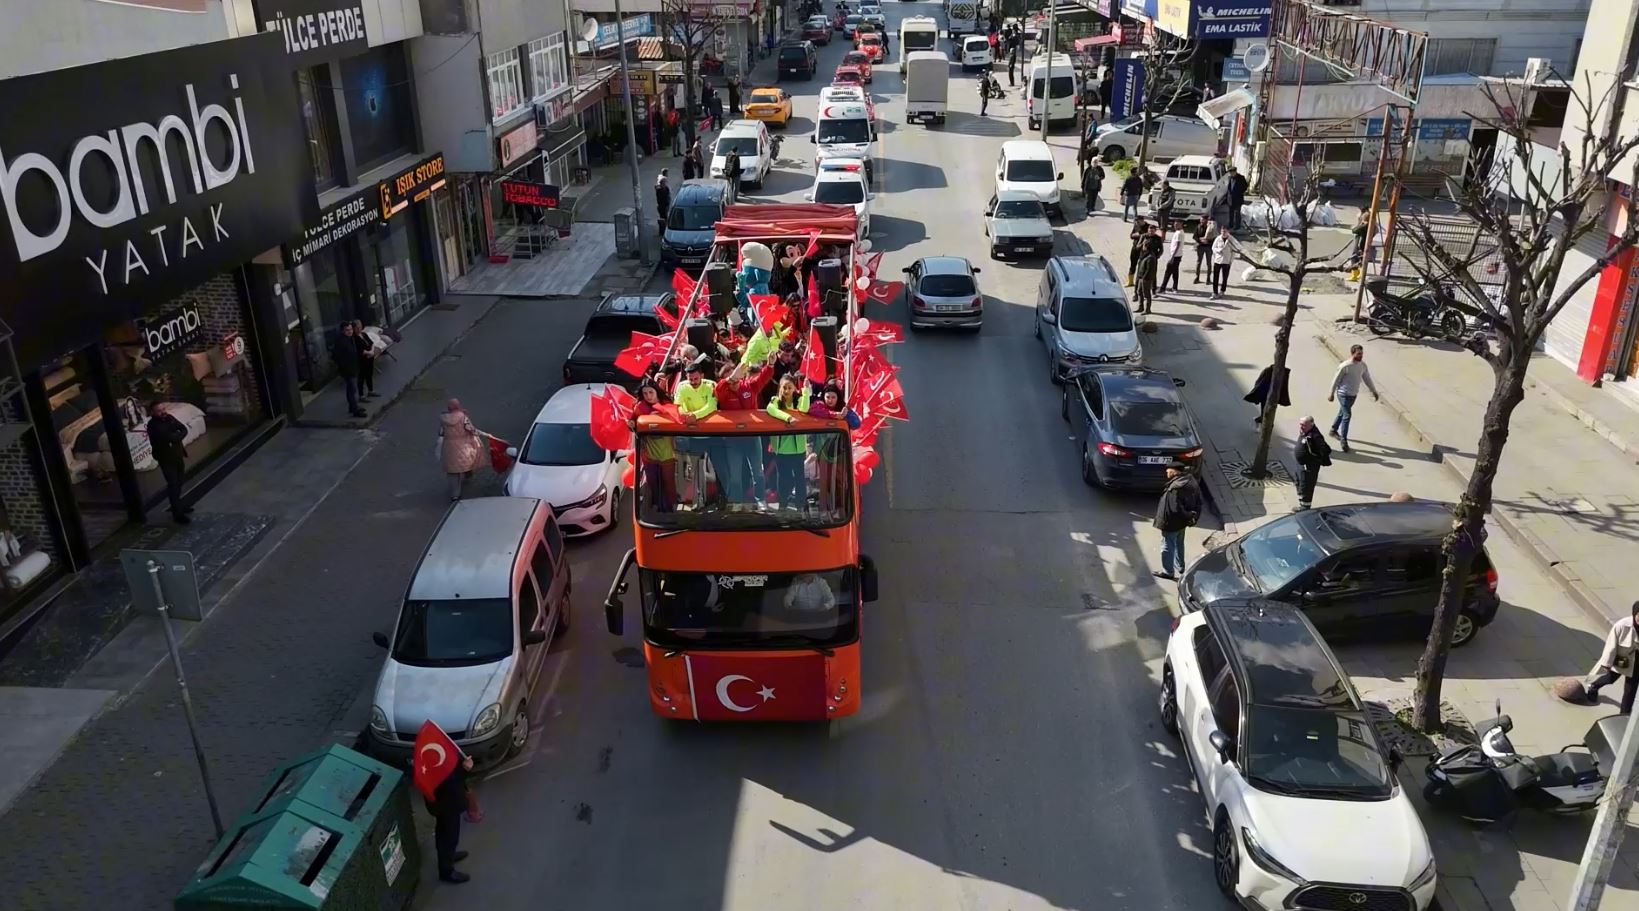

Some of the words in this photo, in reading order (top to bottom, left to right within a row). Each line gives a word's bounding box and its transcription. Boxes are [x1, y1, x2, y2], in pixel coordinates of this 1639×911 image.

[318, 7, 364, 46] PERDE
[1205, 23, 1226, 34] EMA
[1228, 21, 1262, 33] LASTİK
[1216, 7, 1272, 17] MICHELIN
[1122, 64, 1134, 117] MICHELIN
[0, 73, 256, 262] bambi
[415, 156, 444, 184] STORE
[335, 197, 366, 223] PERDE
[504, 194, 557, 207] TOBACCO
[1176, 198, 1197, 206] OTA
[87, 203, 229, 293] YATAK
[293, 249, 303, 264] İÇ
[302, 230, 333, 257] MİMARİ
[333, 207, 378, 241] DEKORASYON
[145, 302, 202, 353] bambi
